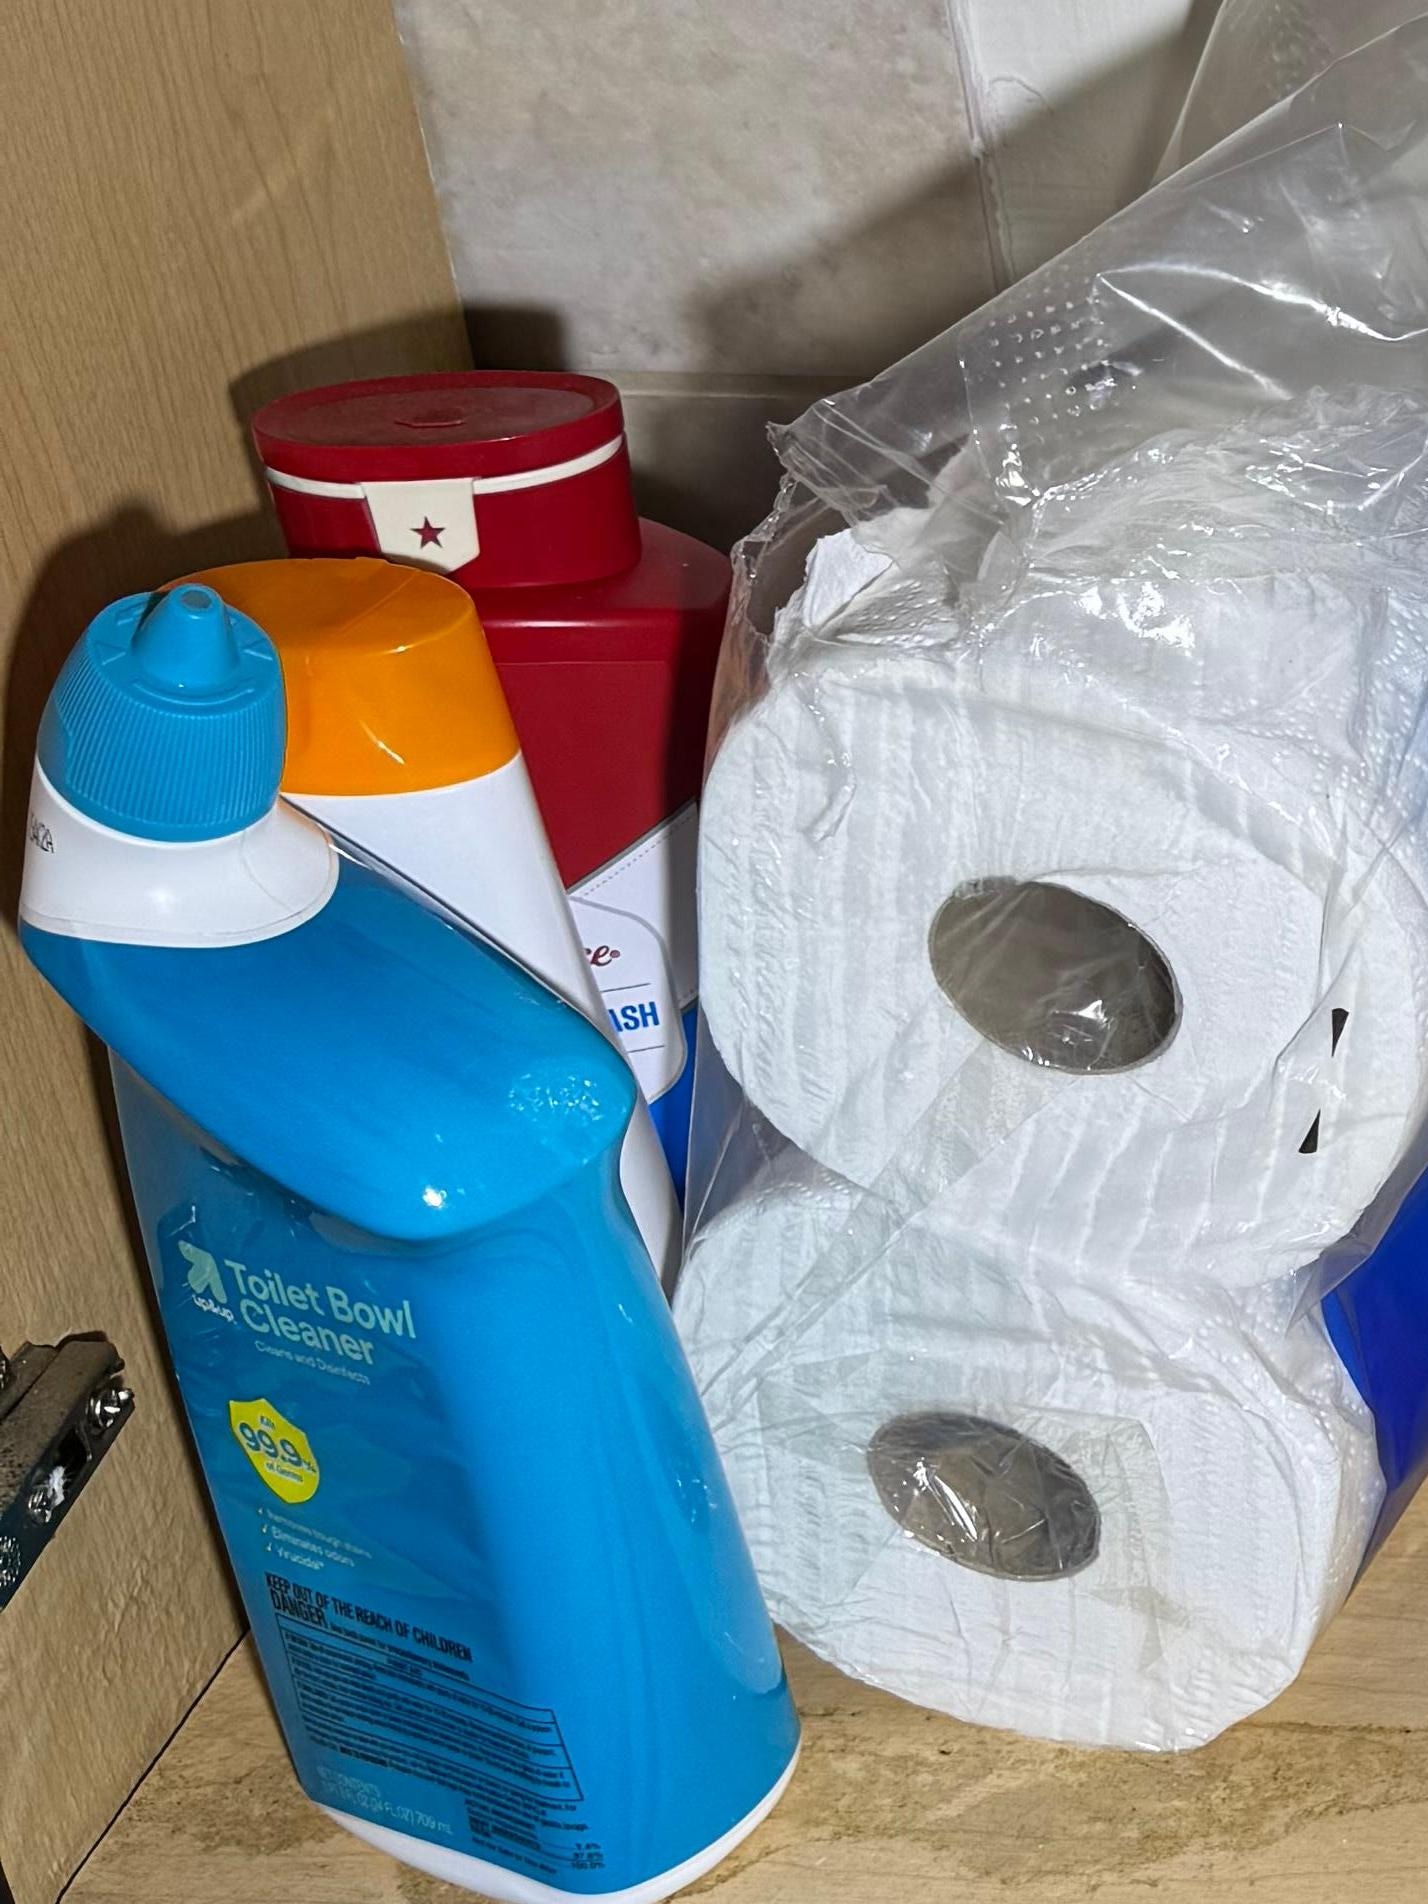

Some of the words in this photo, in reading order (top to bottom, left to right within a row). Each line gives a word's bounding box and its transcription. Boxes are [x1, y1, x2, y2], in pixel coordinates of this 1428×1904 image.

[224, 1259, 325, 1316] Toilet
[326, 1286, 416, 1339] Bowl
[240, 1299, 374, 1365] Cleaner
[265, 1572, 291, 1593] KEEP
[292, 1582, 312, 1602] OUT
[315, 1591, 330, 1608] OF
[331, 1597, 355, 1620] THE
[354, 1606, 394, 1633] REACH
[395, 1619, 410, 1637] OF
[412, 1626, 473, 1663] CHILDREN
[270, 1588, 329, 1630] DANGER
